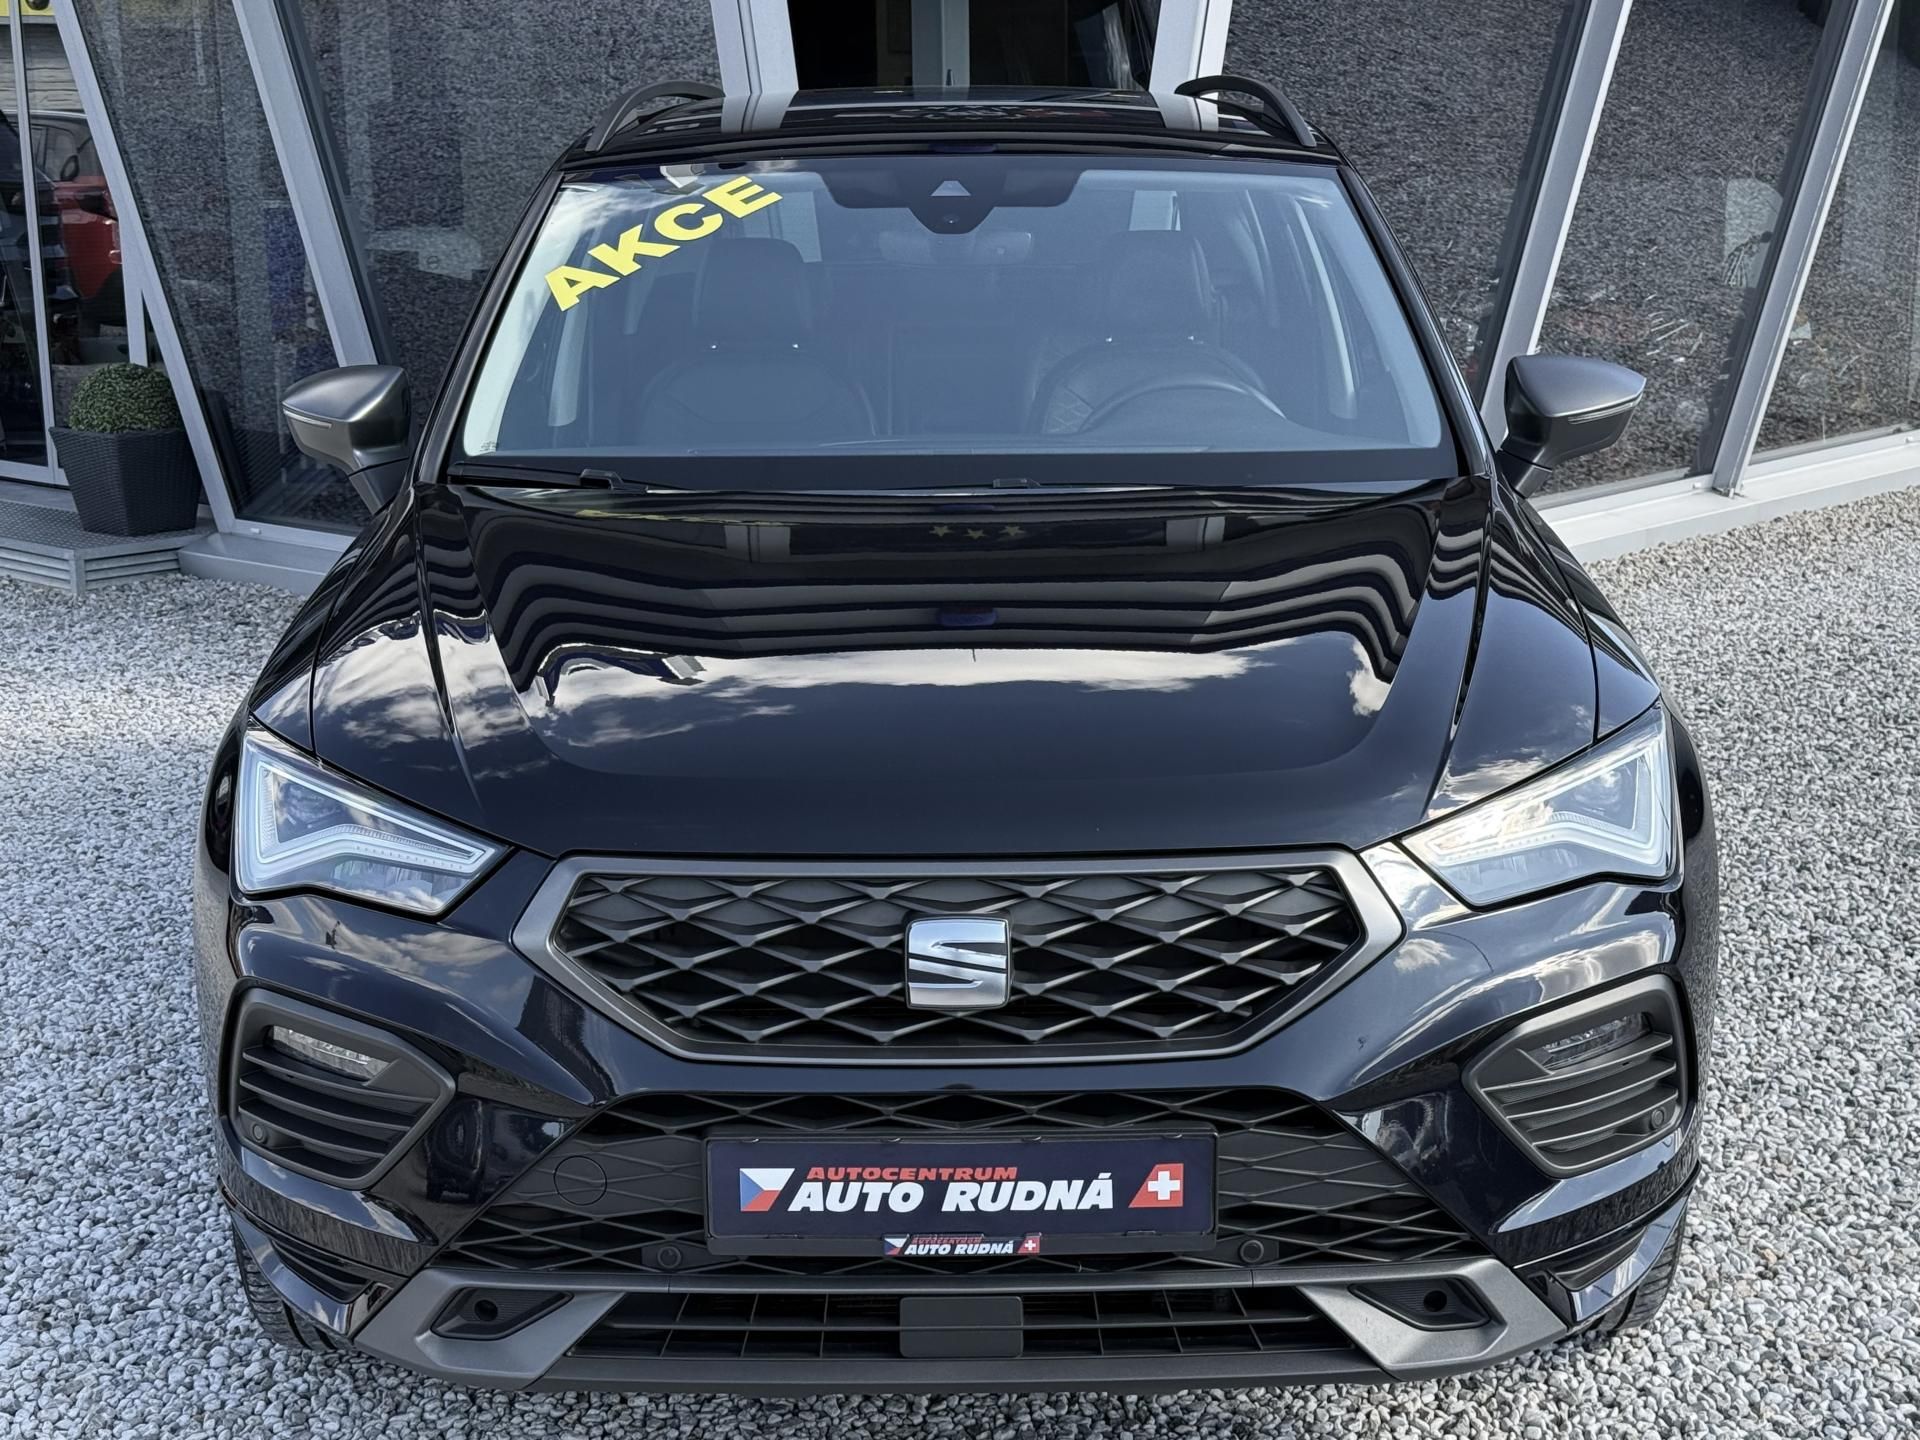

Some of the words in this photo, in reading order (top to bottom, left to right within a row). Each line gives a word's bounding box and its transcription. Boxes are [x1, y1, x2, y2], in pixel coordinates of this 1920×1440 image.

[544, 175, 784, 312] AKCE
[806, 1166, 1018, 1181] AUTOCENTRUM
[787, 1181, 925, 1213] AUTO
[941, 1172, 1114, 1212] RUDNÁ
[904, 1244, 951, 1255] AUTO
[954, 1240, 1014, 1255] RUDNÁ
